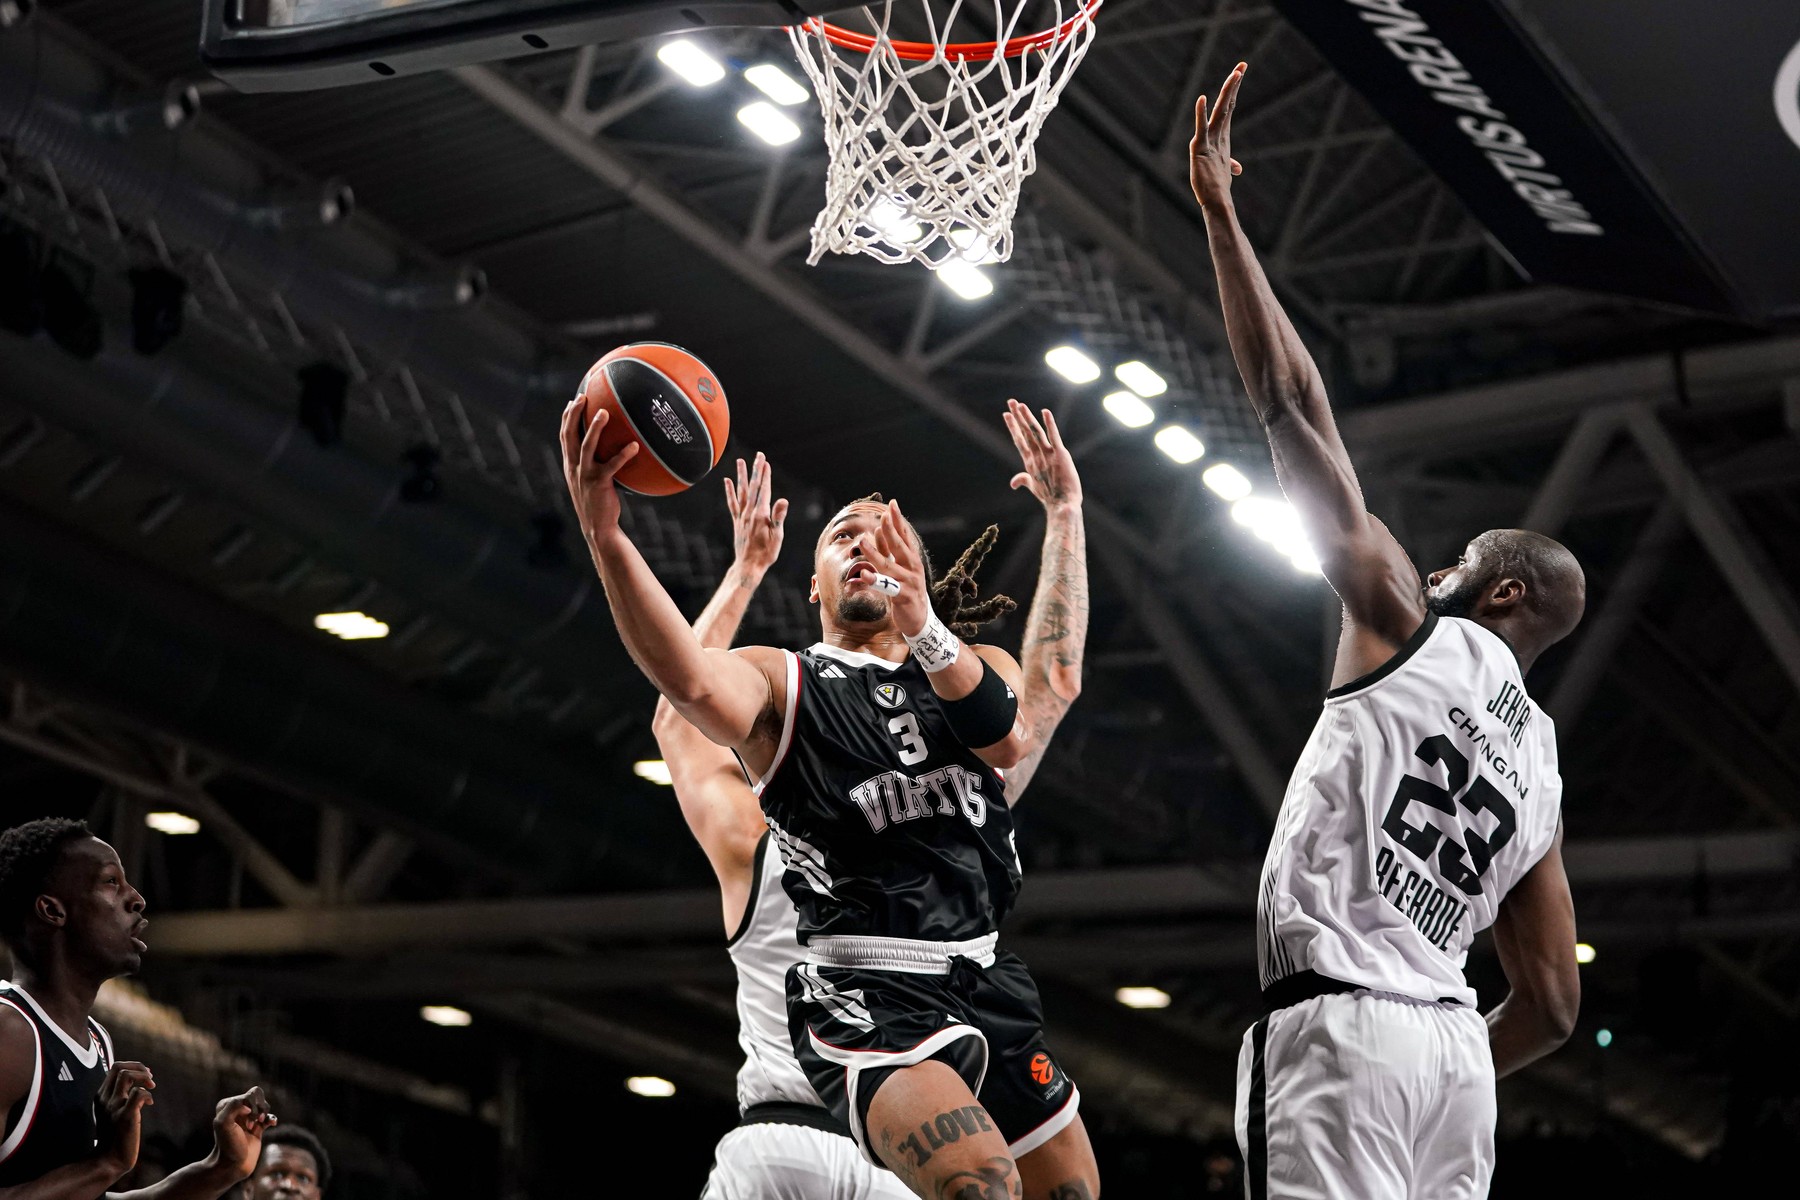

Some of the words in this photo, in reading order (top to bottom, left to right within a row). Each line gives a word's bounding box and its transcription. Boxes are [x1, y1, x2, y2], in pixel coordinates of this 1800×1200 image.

[1456, 115, 1604, 236] VIRTUS
[887, 712, 928, 766] 3
[1381, 733, 1517, 896] 23
